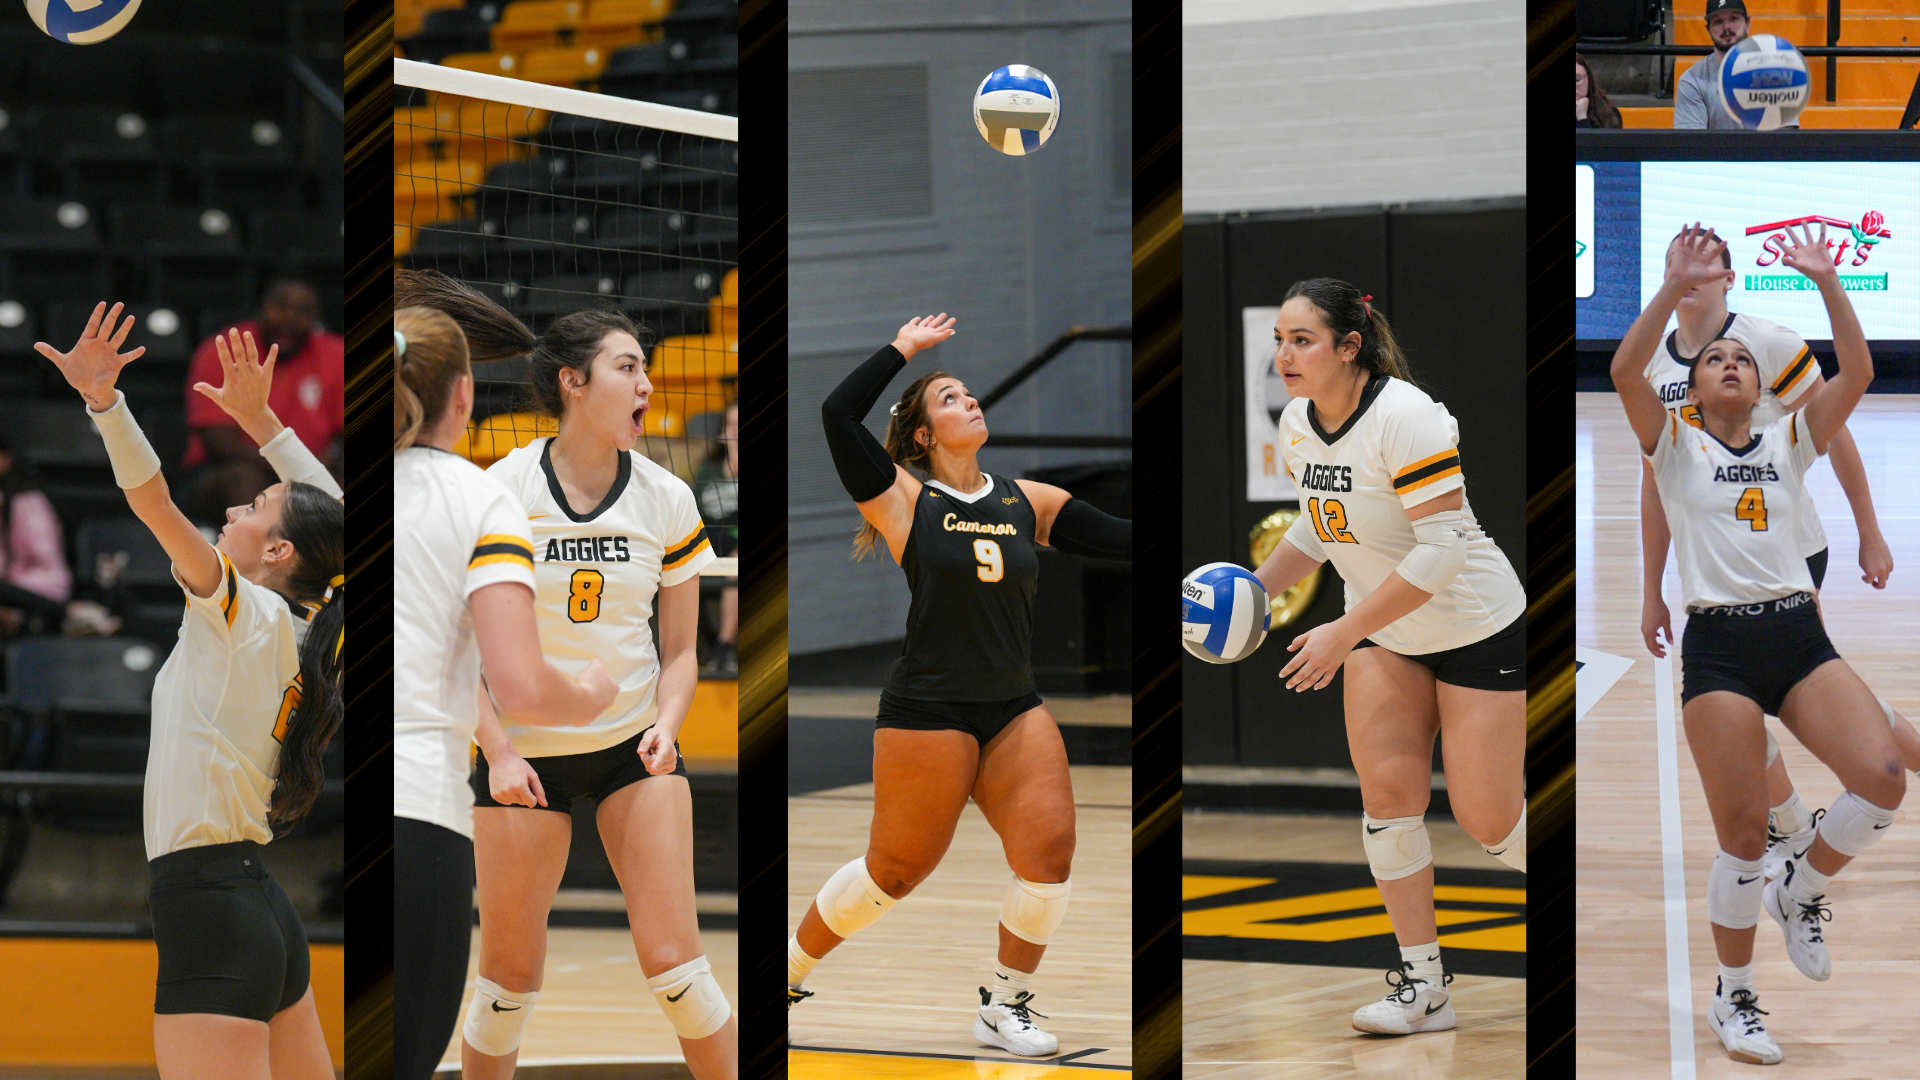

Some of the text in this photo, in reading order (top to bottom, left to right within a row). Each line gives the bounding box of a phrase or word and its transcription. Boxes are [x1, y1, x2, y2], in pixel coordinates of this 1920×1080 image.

[1748, 89, 1800, 105] molten
[1750, 275, 1799, 291] House
[1839, 278, 1884, 291] owers
[1659, 381, 1689, 404] AGG
[1302, 463, 1352, 493] AGGIES
[1713, 463, 1780, 482] AGGIES
[1307, 496, 1360, 545] 12
[1735, 487, 1768, 532] 4
[943, 512, 1017, 536] Cameron
[544, 536, 631, 562] AGGIES
[972, 538, 1004, 583] 9
[567, 568, 605, 624] 8
[1774, 591, 1812, 613] NIKE
